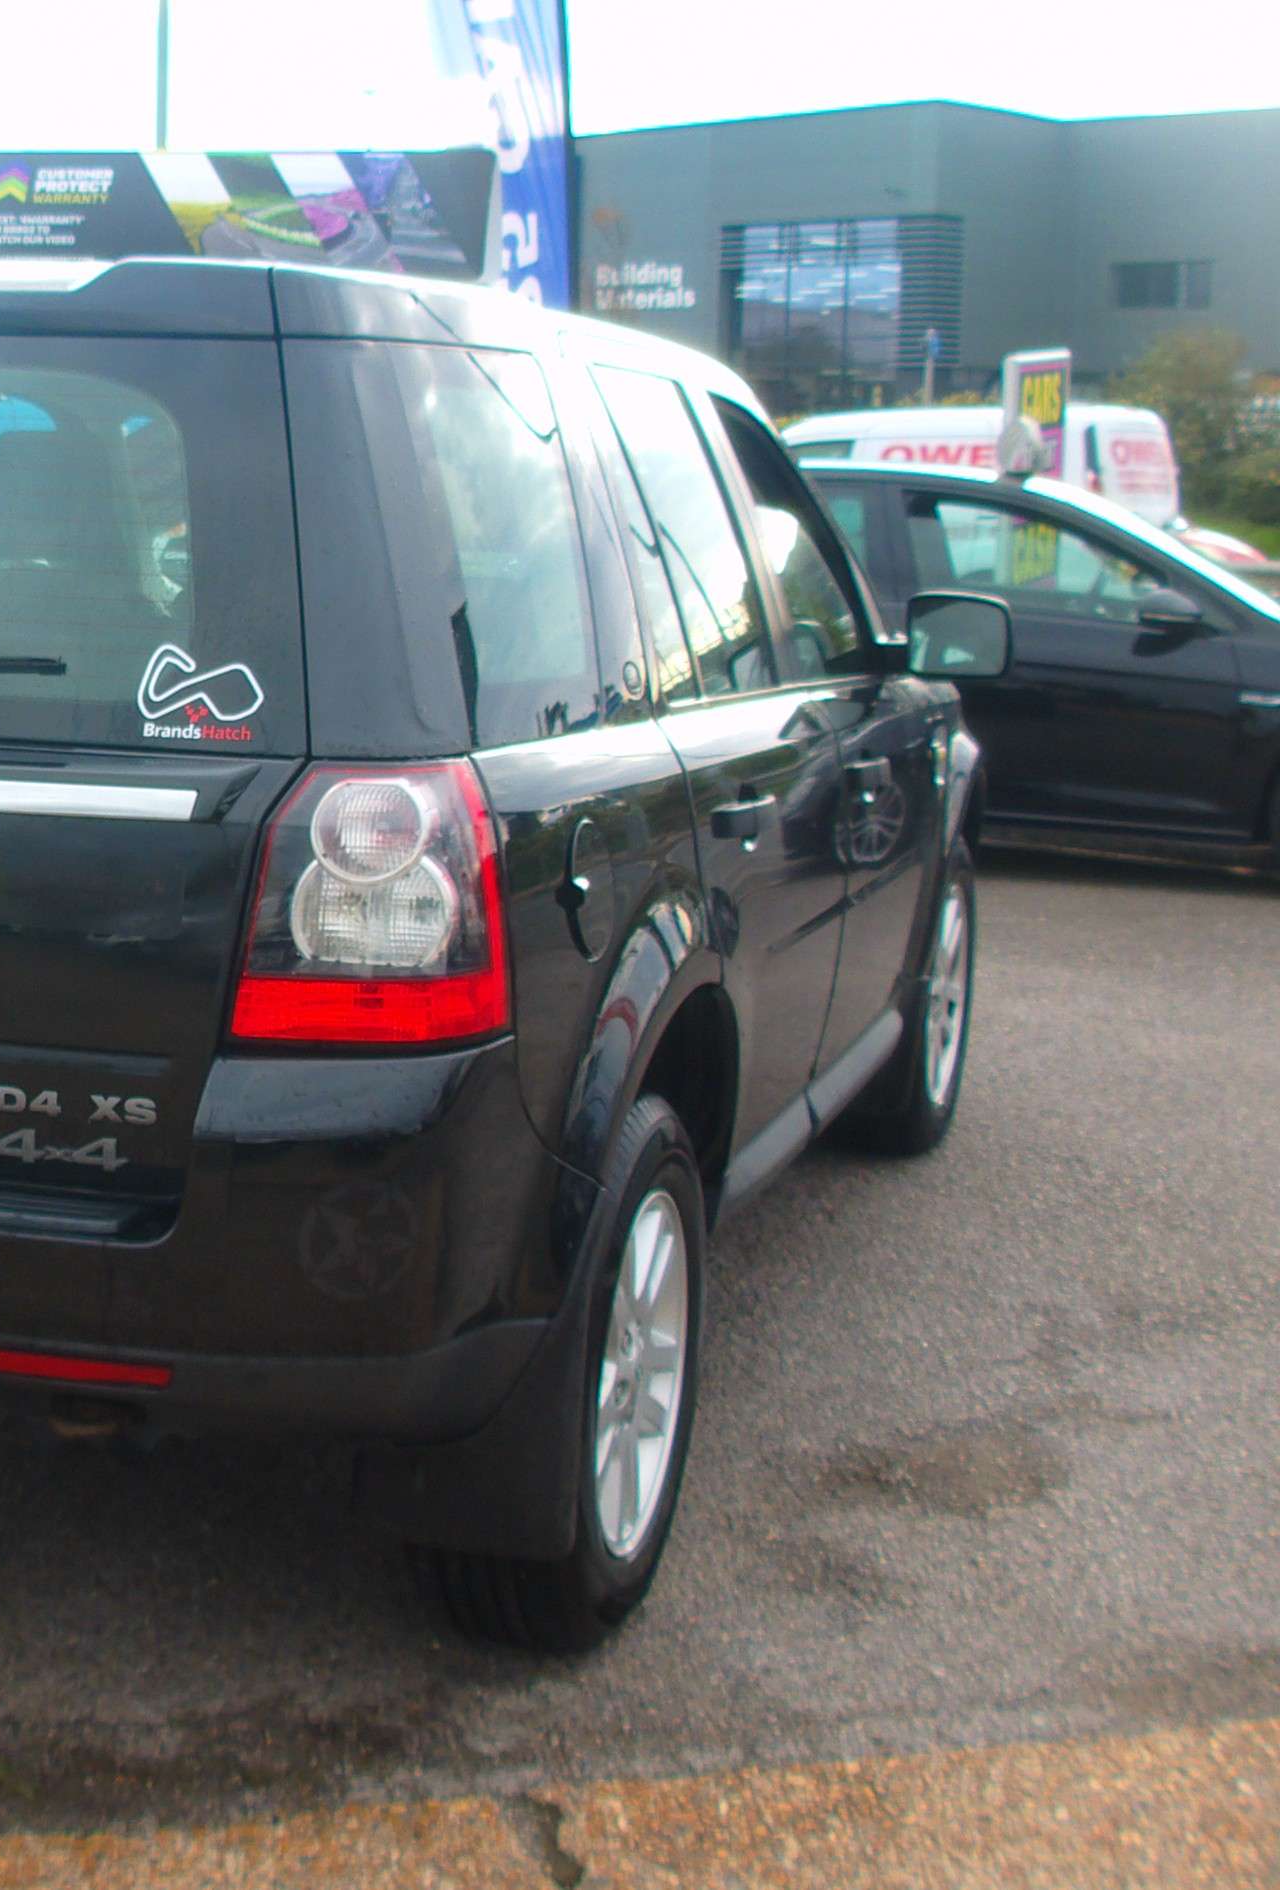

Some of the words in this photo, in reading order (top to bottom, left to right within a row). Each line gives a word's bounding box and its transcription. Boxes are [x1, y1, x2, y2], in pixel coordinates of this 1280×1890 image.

[37, 167, 113, 180] CUSTOMER
[34, 180, 112, 193] PROTECT
[31, 192, 109, 204] WARRANTY
[596, 259, 683, 290] Building
[1022, 370, 1062, 425] CARS
[142, 721, 251, 741] BrandsHatch
[88, 1093, 158, 1127] XS
